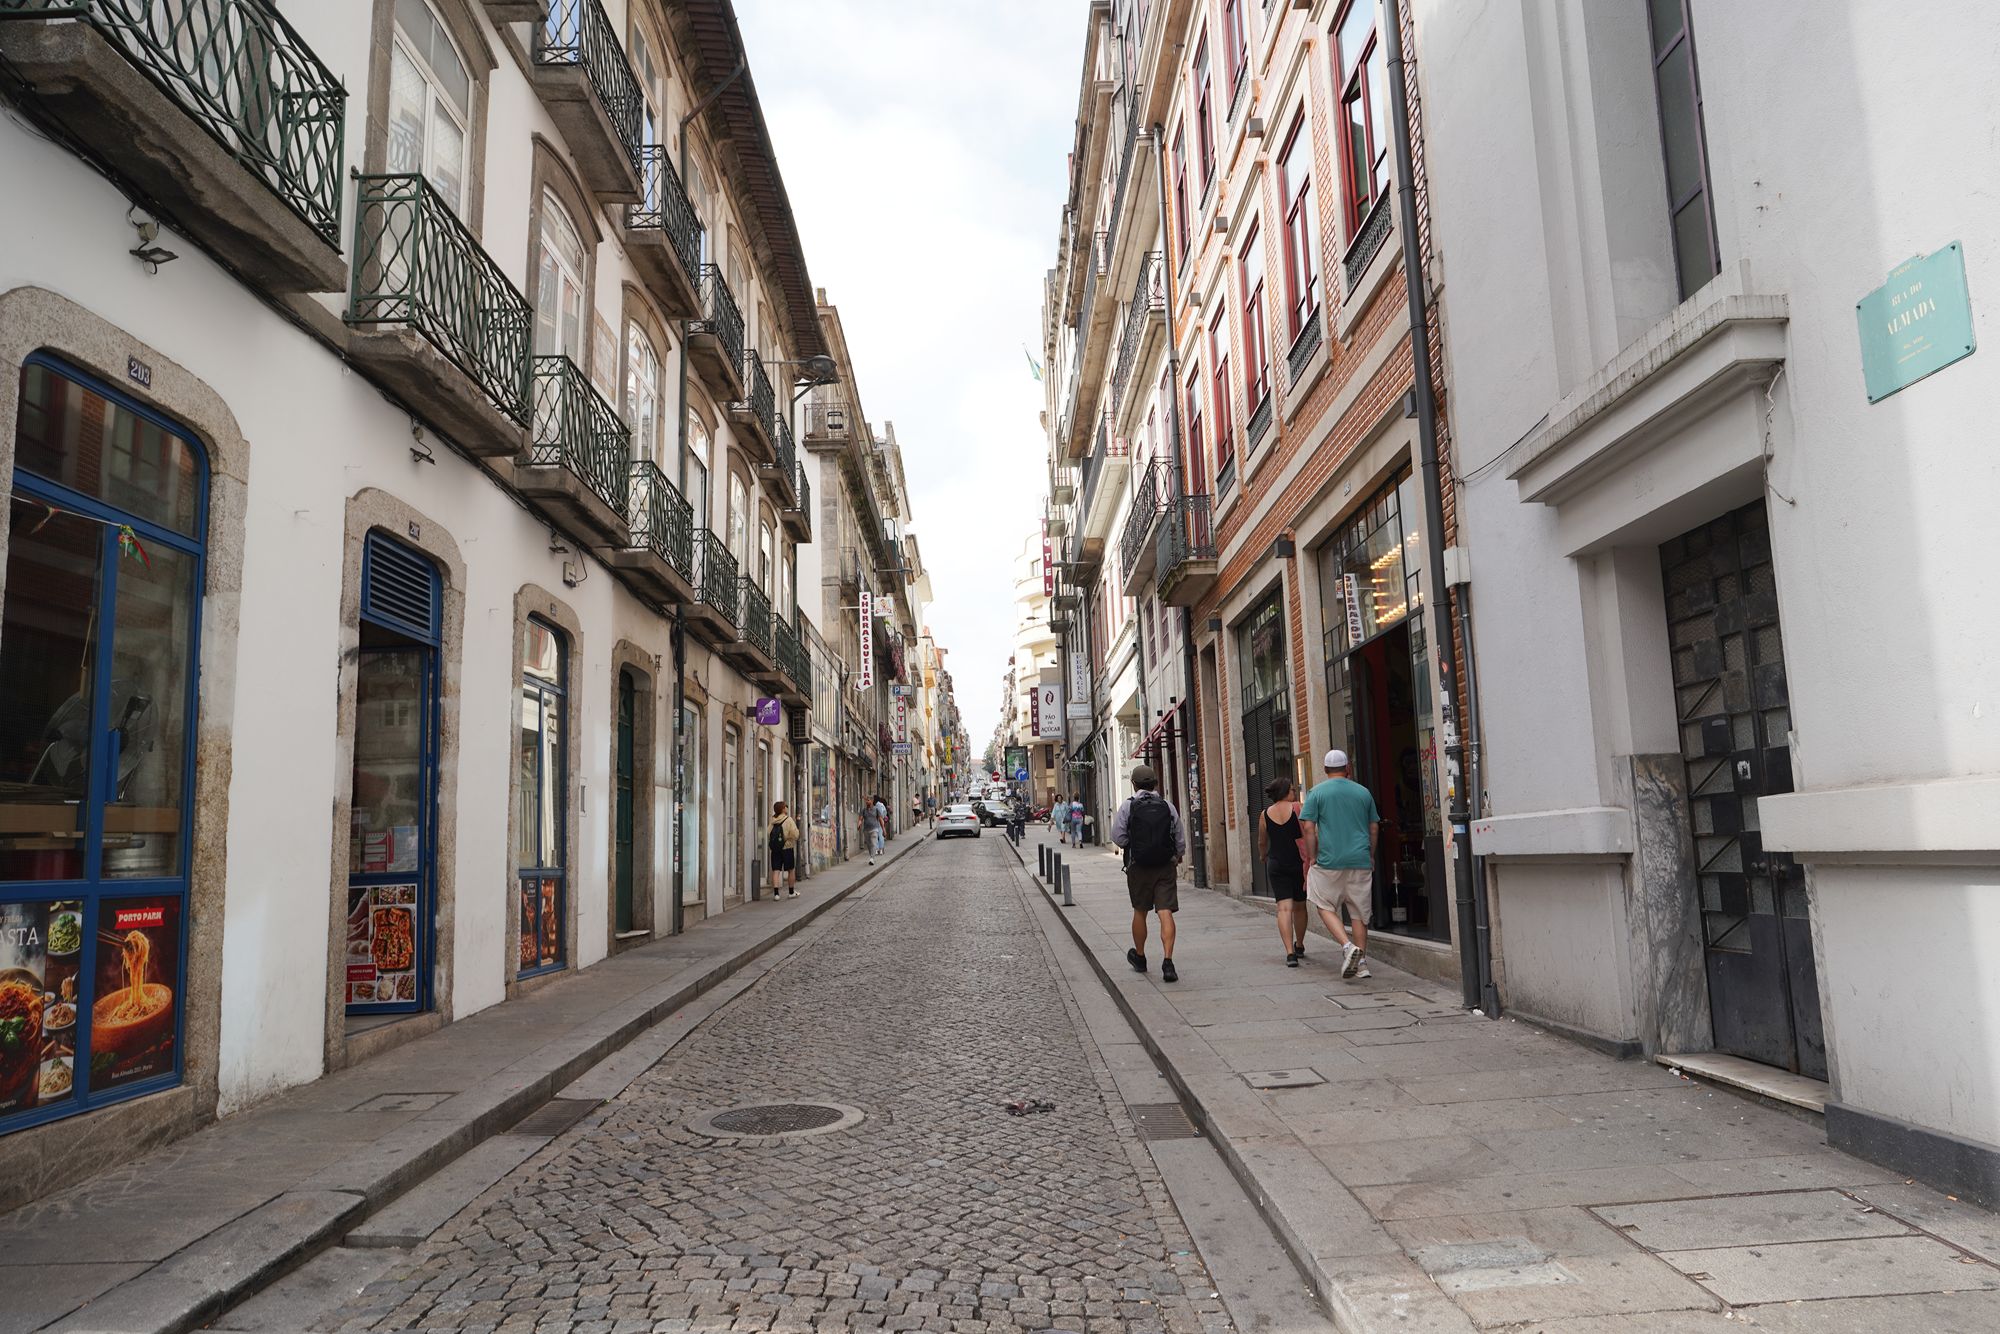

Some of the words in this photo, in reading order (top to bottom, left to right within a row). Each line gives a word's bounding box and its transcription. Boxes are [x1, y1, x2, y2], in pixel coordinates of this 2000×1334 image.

[1887, 297, 1936, 335] ALMADA
[130, 360, 150, 385] 203
[861, 594, 871, 686] CHURRASQUEIRA
[894, 686, 900, 694] P
[1076, 654, 1084, 701] FERRAGENS
[1041, 725, 1060, 733] AÇÚCAR
[118, 912, 142, 923] PORTO
